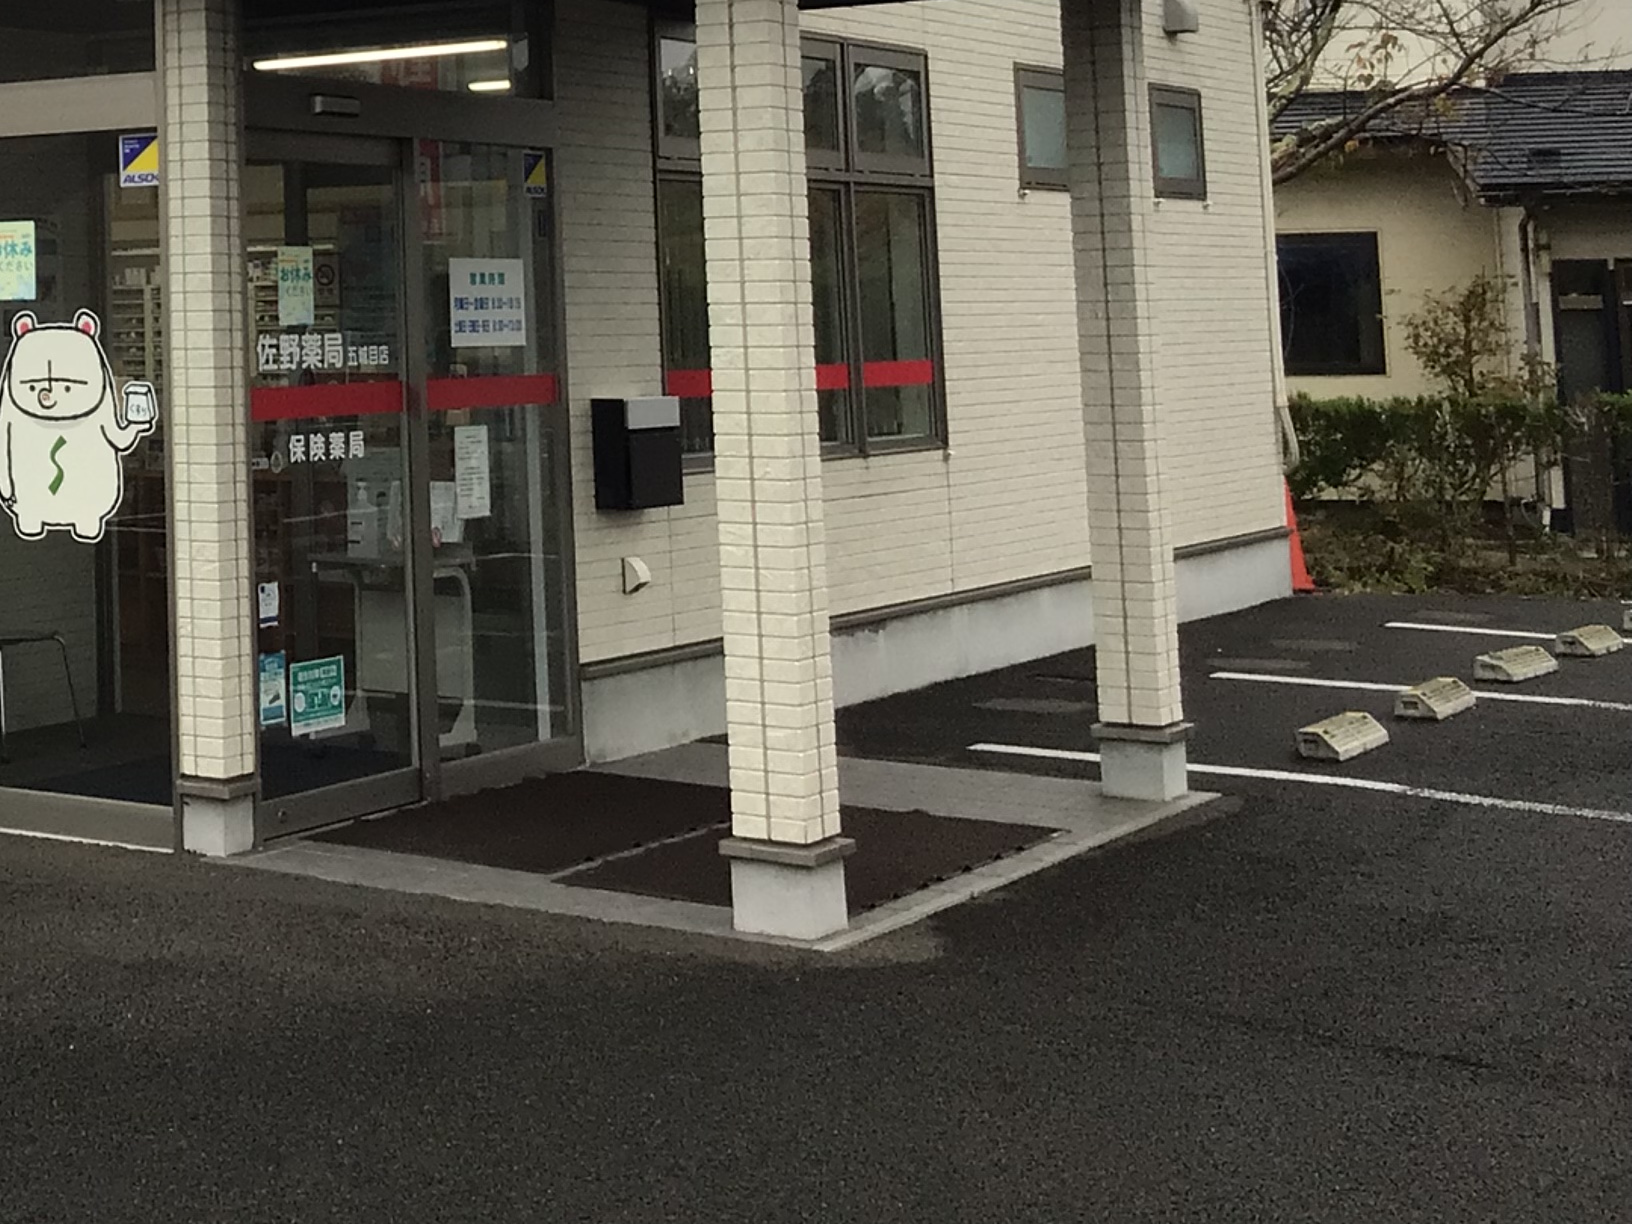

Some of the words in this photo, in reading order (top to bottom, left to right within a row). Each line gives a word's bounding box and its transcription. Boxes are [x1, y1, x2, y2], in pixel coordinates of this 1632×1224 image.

[256, 332, 344, 373] 佐野薬局
[348, 345, 390, 367] 五城目店
[288, 430, 366, 464] 保険薬局
